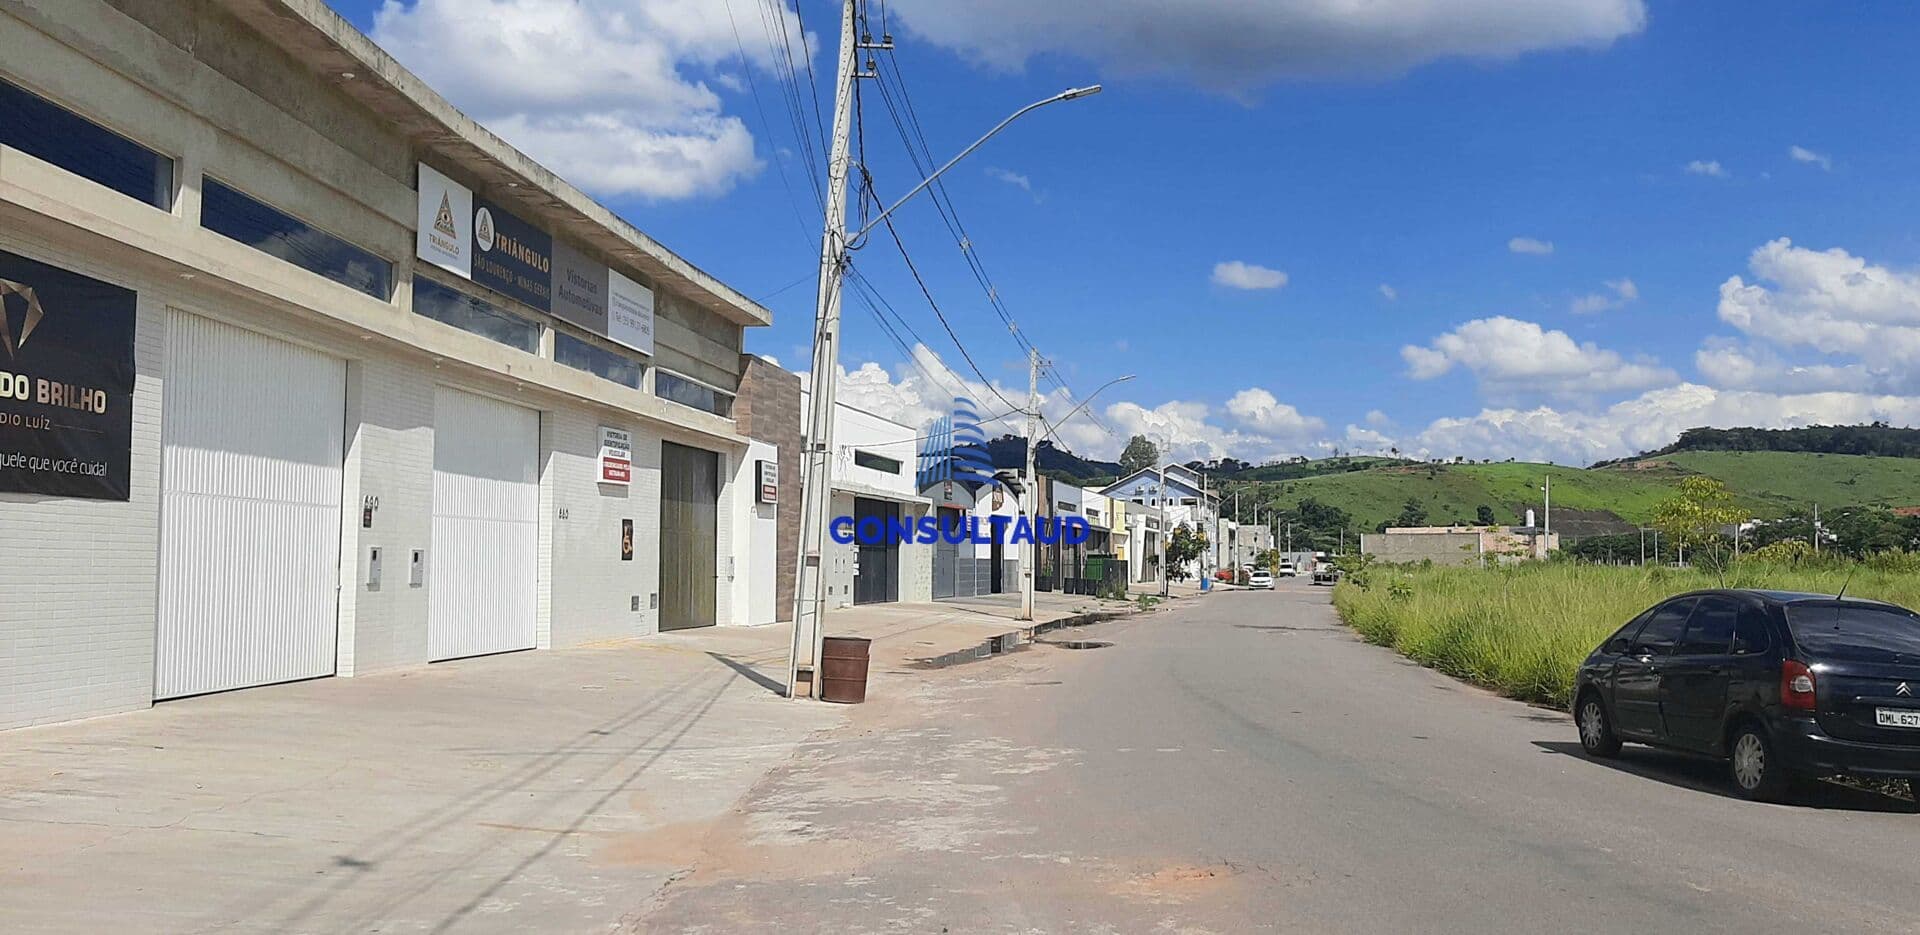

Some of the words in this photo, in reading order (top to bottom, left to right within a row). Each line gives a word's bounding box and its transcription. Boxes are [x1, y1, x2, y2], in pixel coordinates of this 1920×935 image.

[495, 232, 549, 273] TRIÂNGULO
[566, 268, 598, 294] Vistorias
[37, 378, 106, 414] BRILHO
[25, 414, 50, 430] LUÍZ
[28, 456, 50, 474] que
[52, 458, 78, 474] você
[1901, 715, 1920, 725] 627
